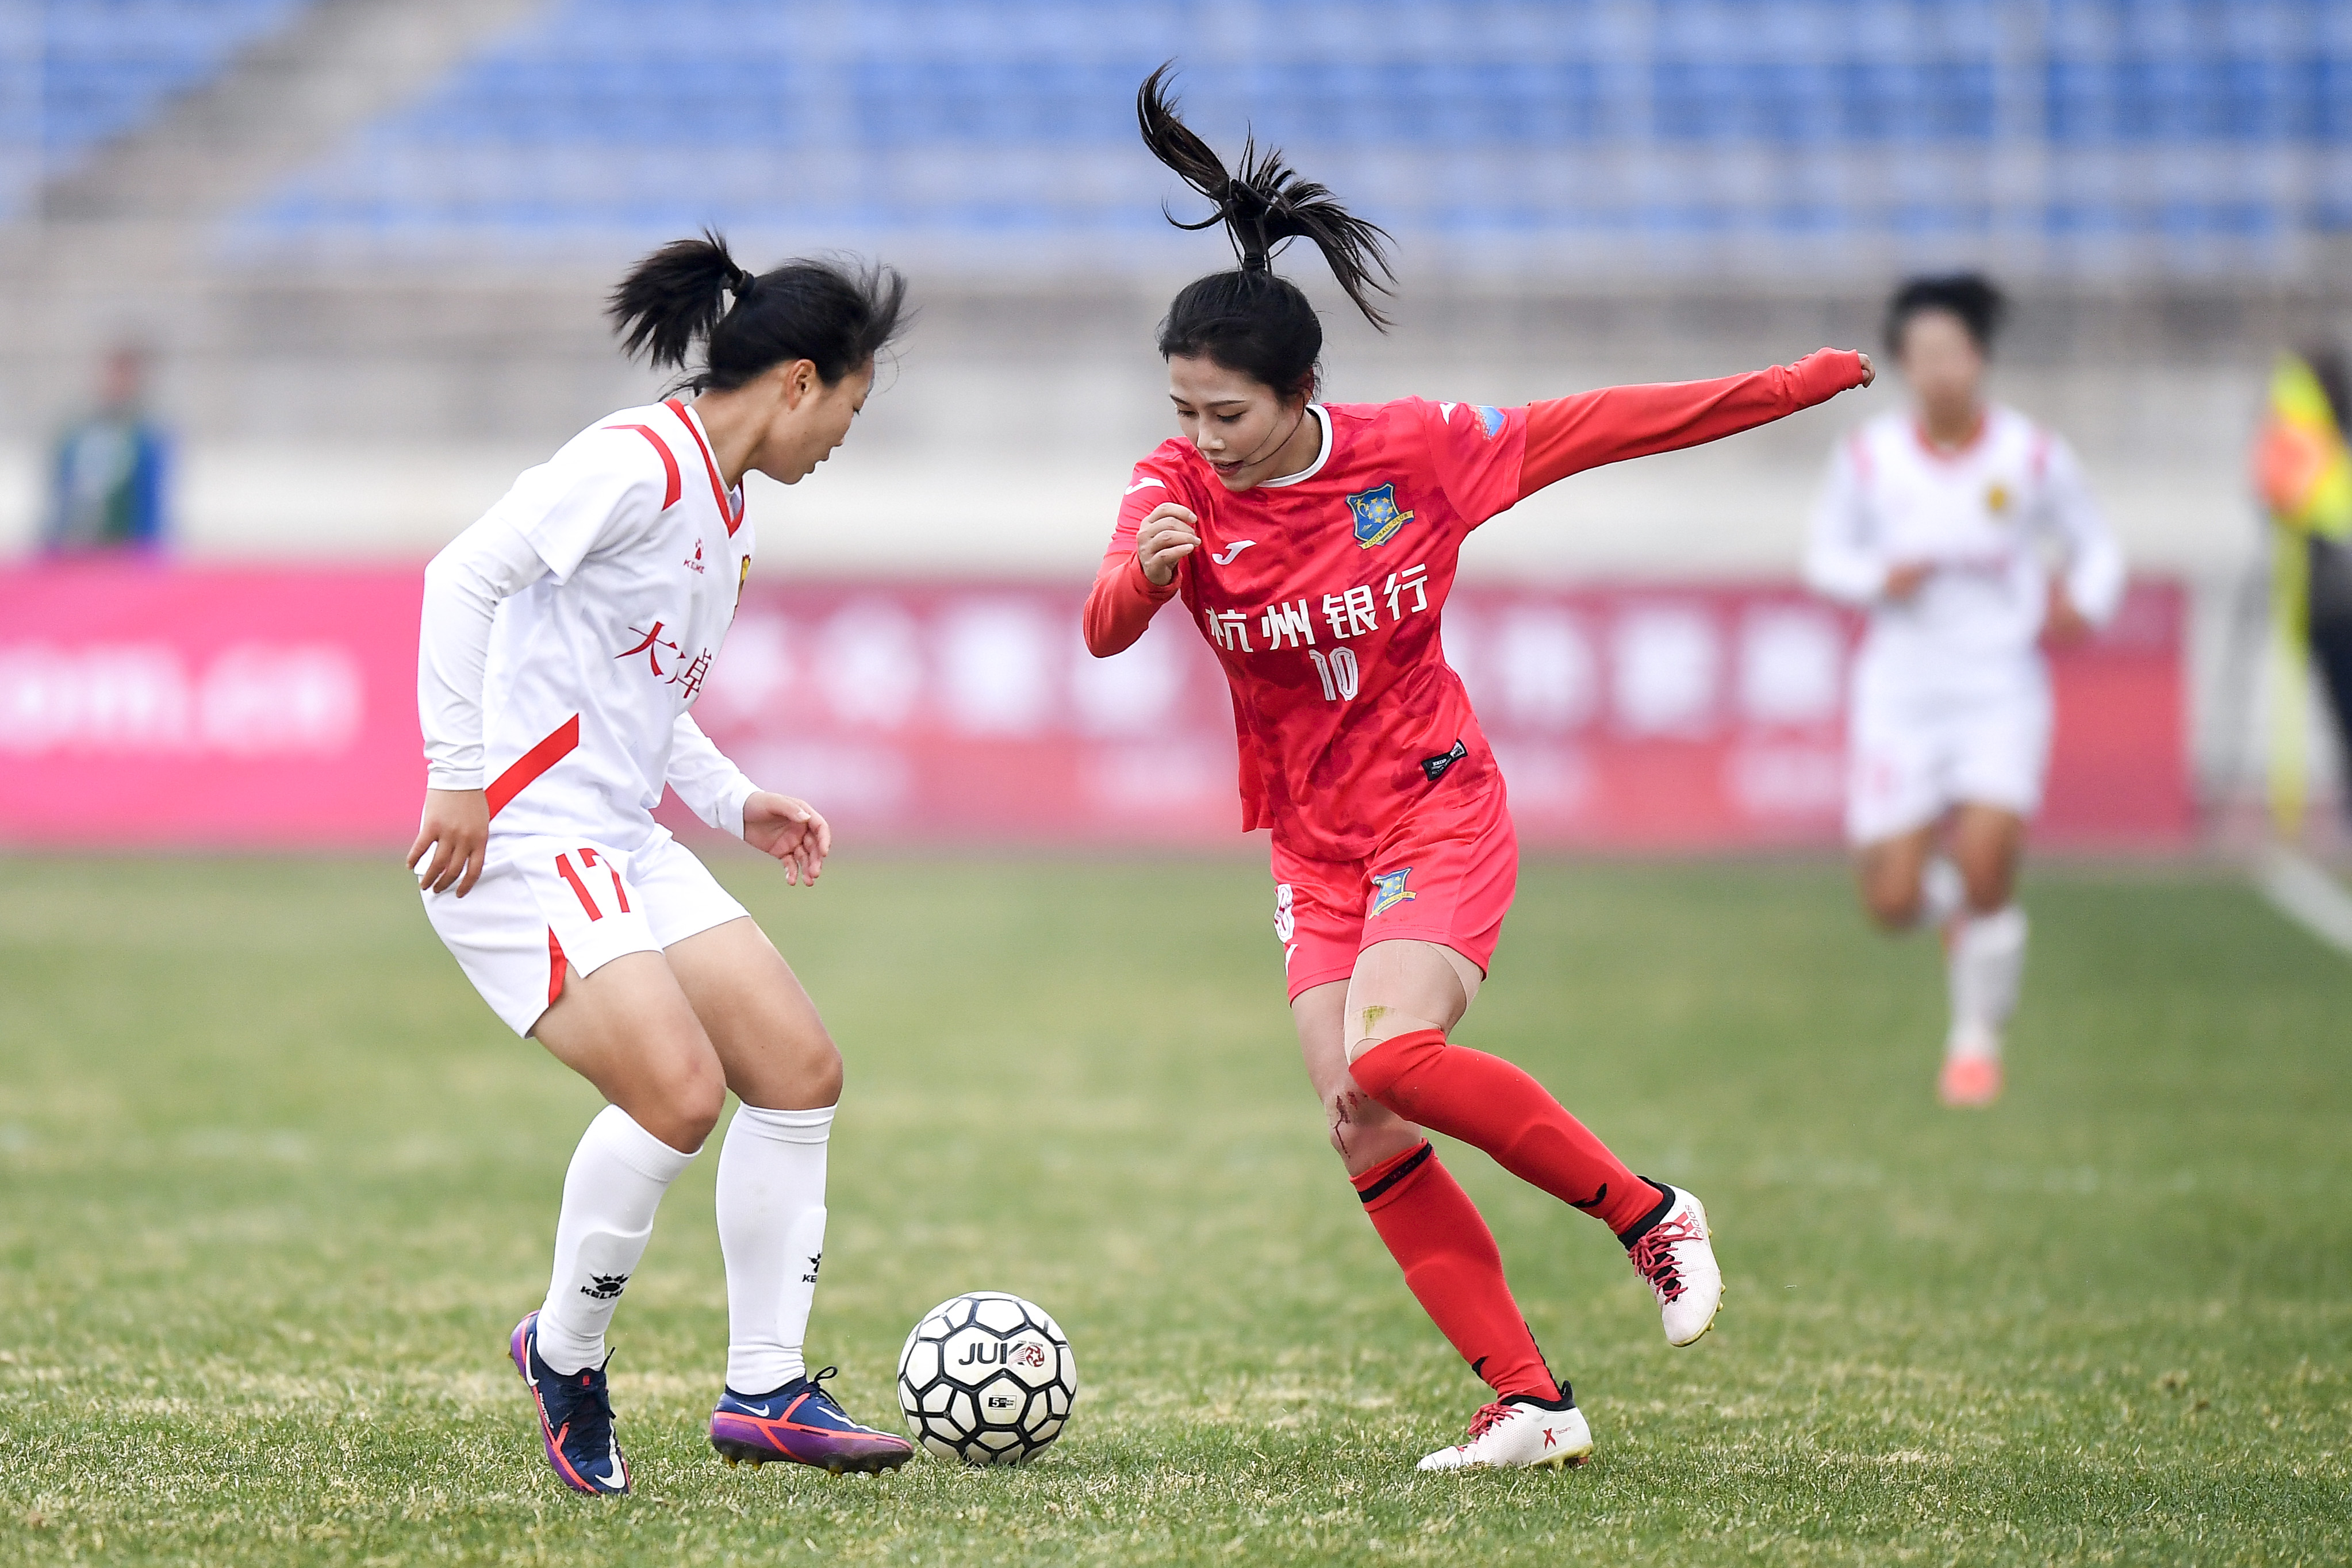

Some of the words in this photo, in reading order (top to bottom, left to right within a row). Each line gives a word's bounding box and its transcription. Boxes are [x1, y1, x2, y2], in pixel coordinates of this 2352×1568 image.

[1364, 525, 1392, 548] FOOTBALL
[1392, 513, 1409, 525] CLUB
[1205, 563, 1429, 653] 杭州银行
[1309, 646, 1359, 702] 10
[555, 848, 631, 923] 17
[1685, 1204, 1704, 1238] didas
[991, 1398, 1000, 1407] 5
